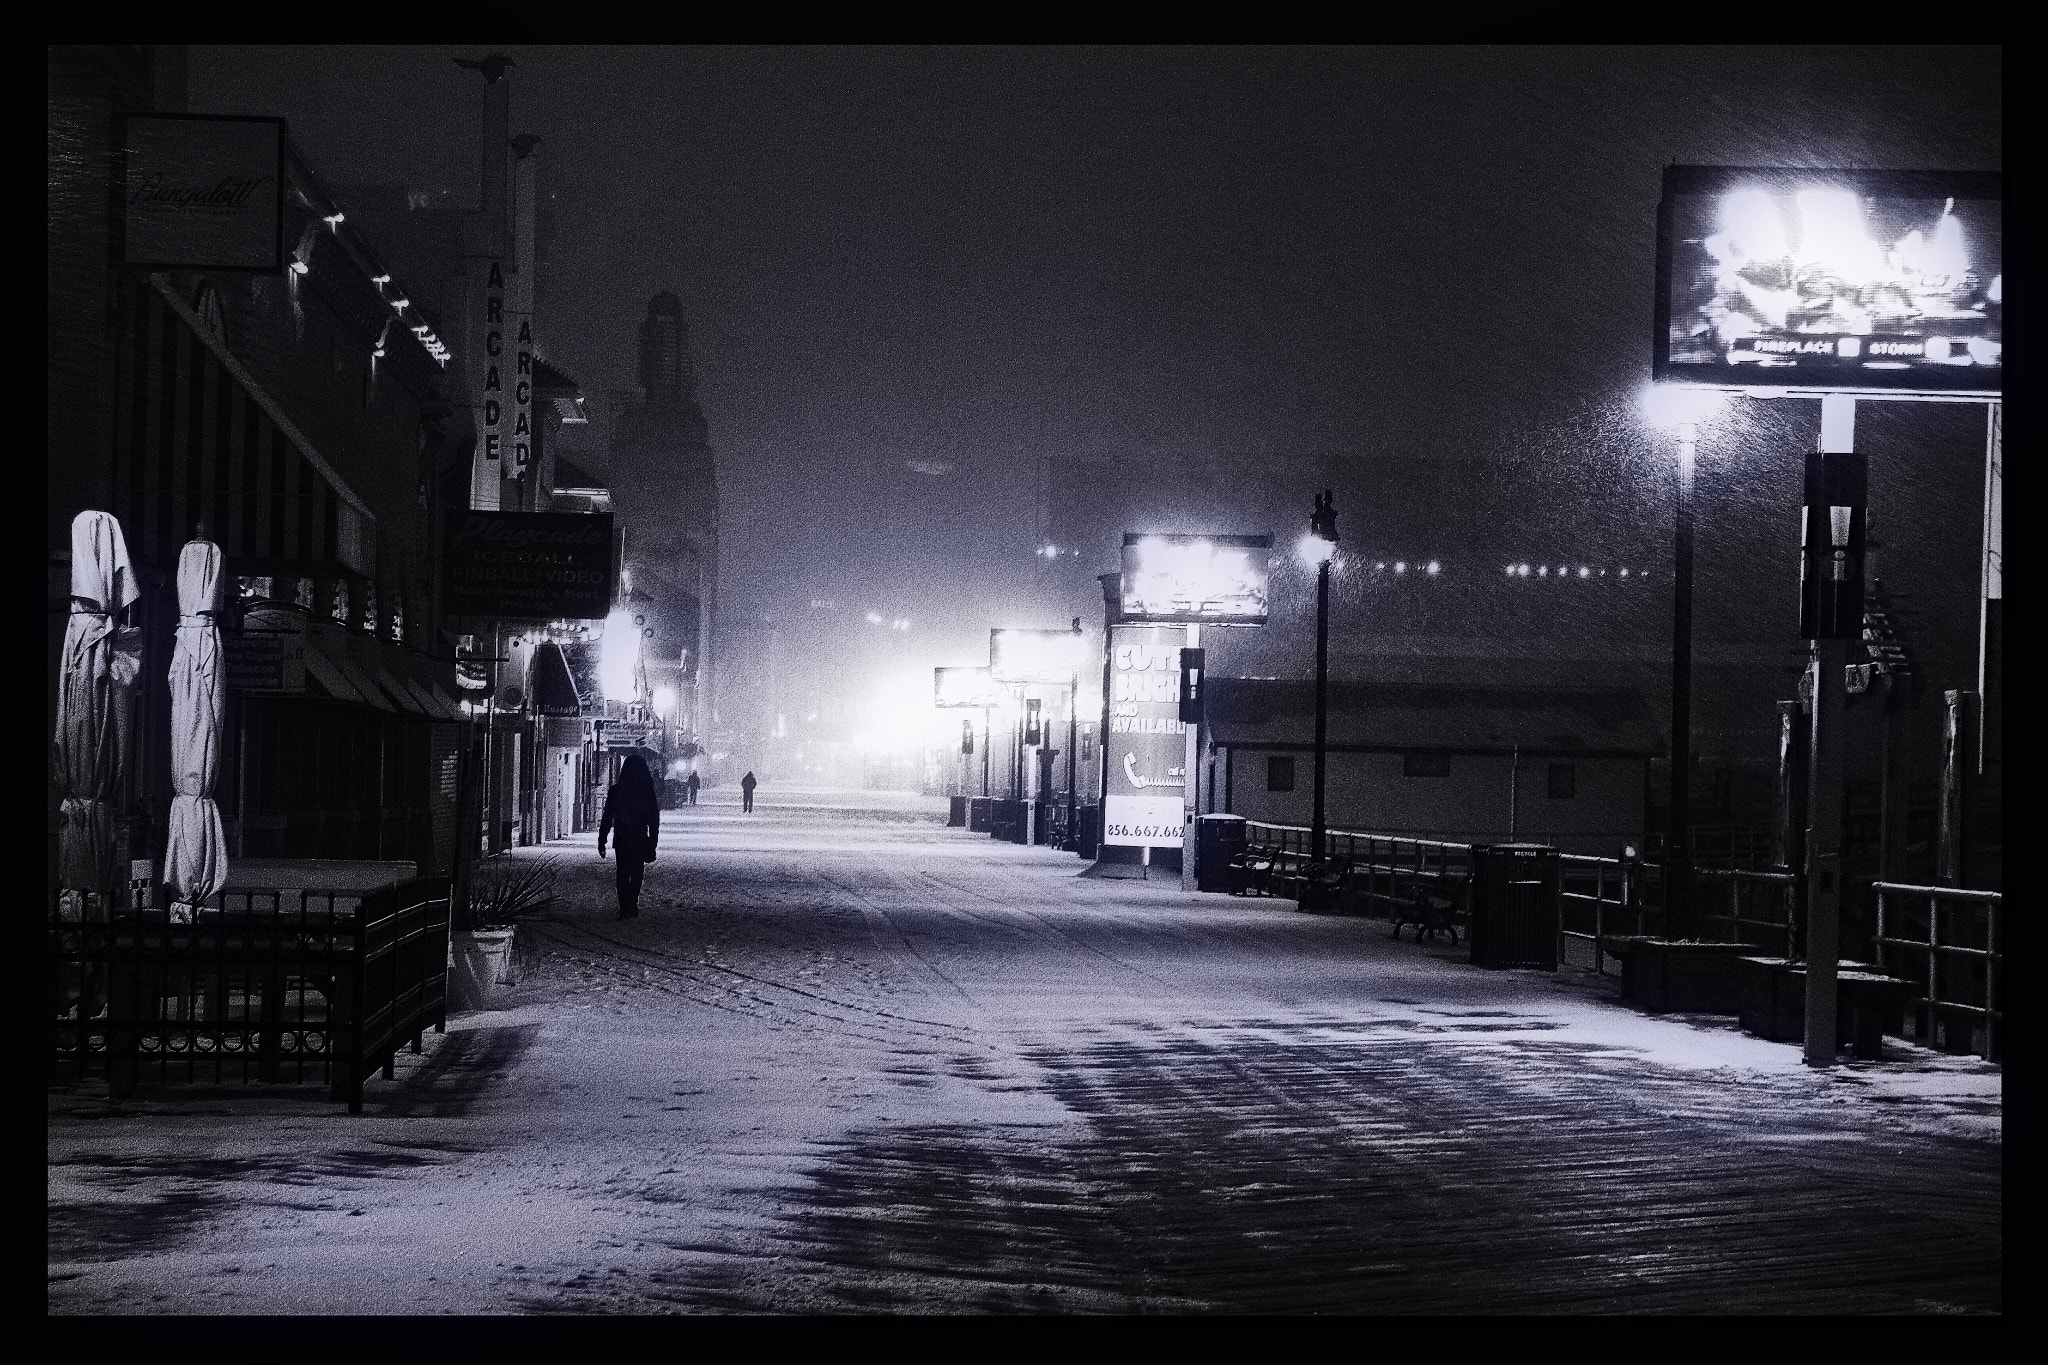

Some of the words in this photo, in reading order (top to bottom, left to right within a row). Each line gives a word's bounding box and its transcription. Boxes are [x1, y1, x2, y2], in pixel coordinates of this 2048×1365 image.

[484, 261, 504, 461] ARCADE
[515, 320, 533, 482] ARCAD
[451, 515, 605, 548] Playcade
[473, 550, 582, 565] ICEBALL
[545, 569, 605, 584] VIDEO
[1115, 673, 1180, 703] BRIGH
[1114, 703, 1138, 717] AND
[1108, 824, 1185, 838] 856.667.662
